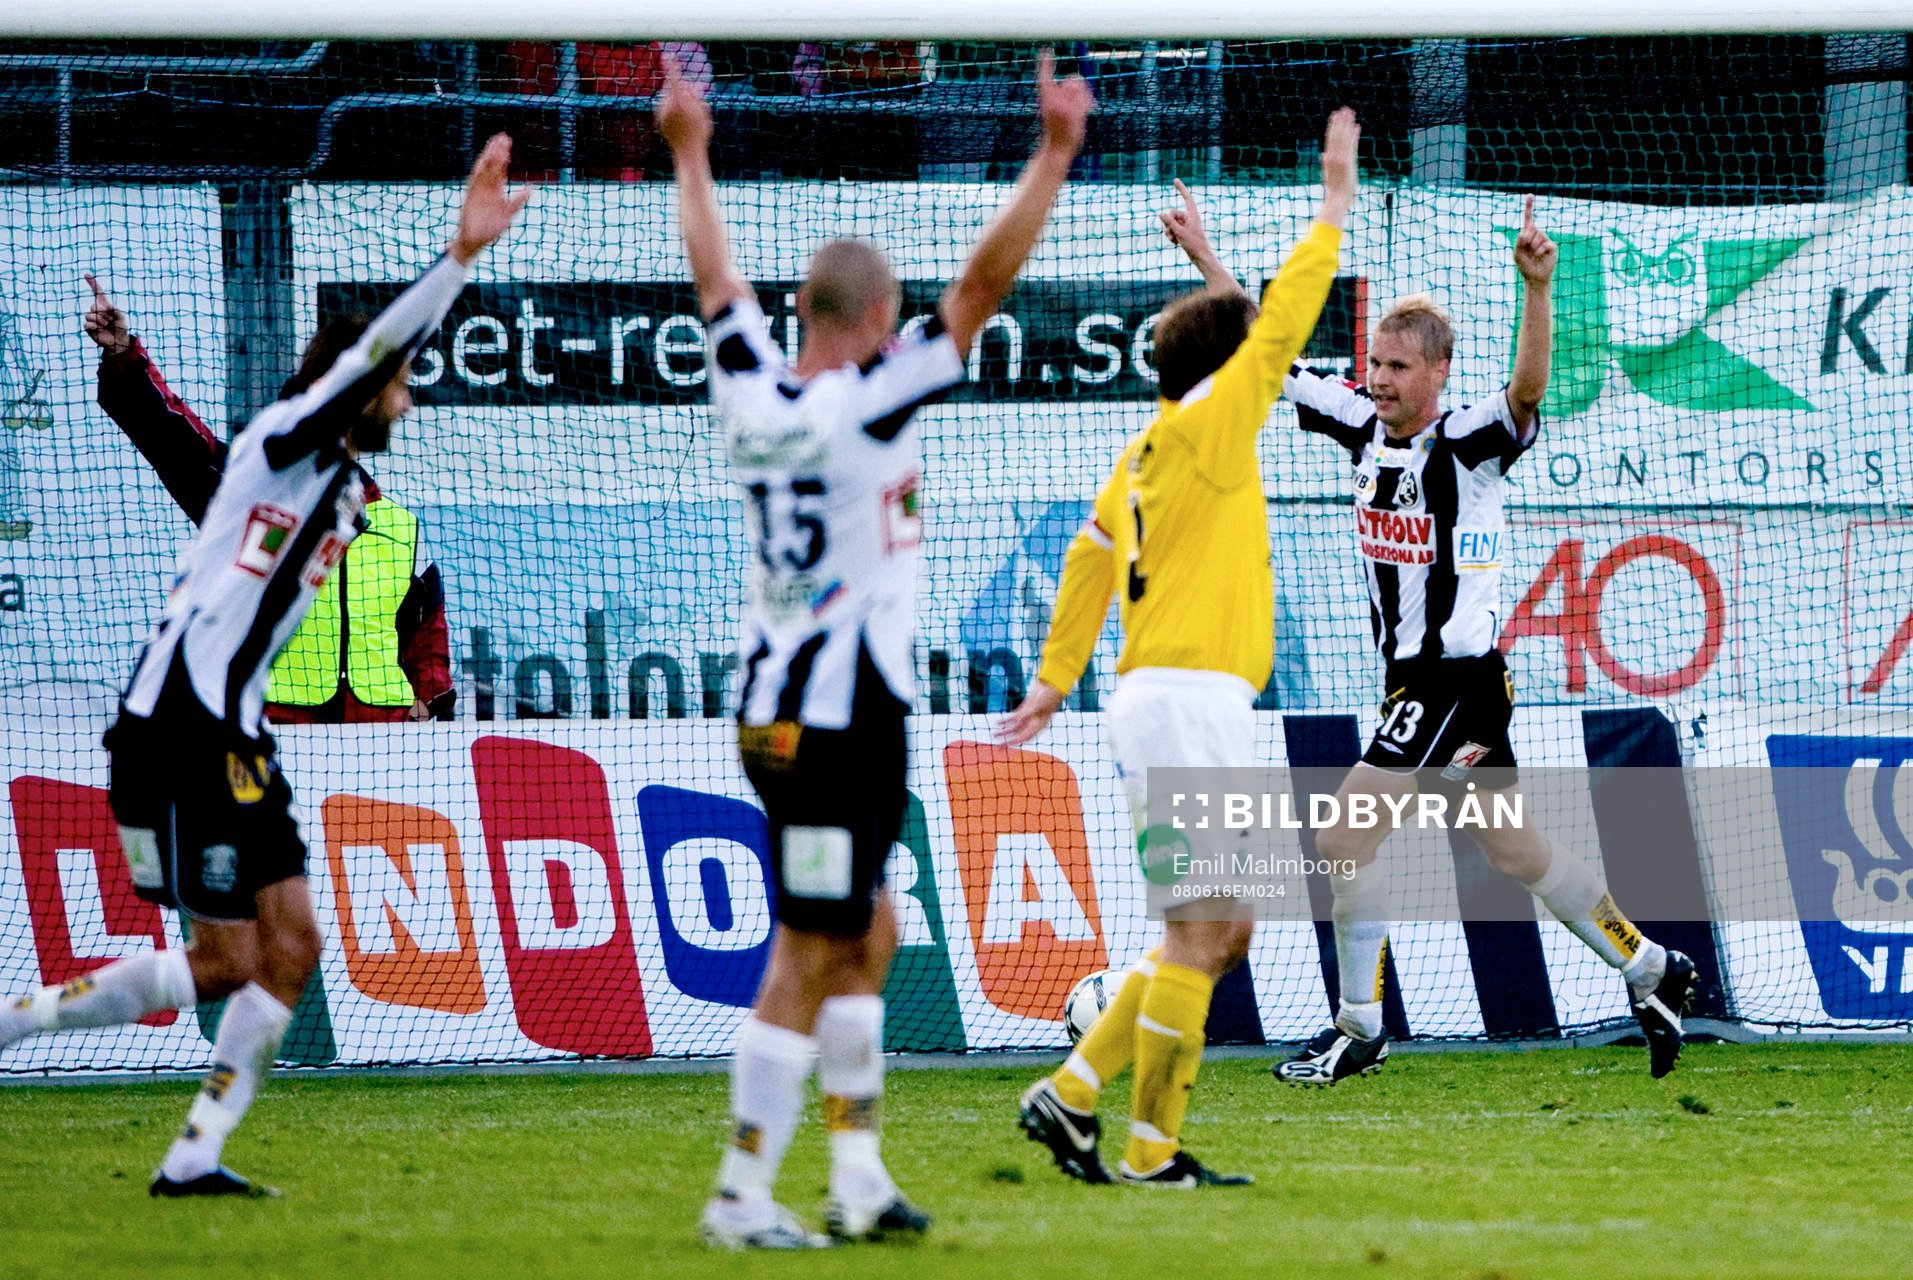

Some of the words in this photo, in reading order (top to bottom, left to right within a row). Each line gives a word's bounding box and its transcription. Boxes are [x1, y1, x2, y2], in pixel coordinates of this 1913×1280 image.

[1820, 287, 1913, 374] K
[750, 480, 827, 574] 15
[1380, 700, 1425, 743] 13
